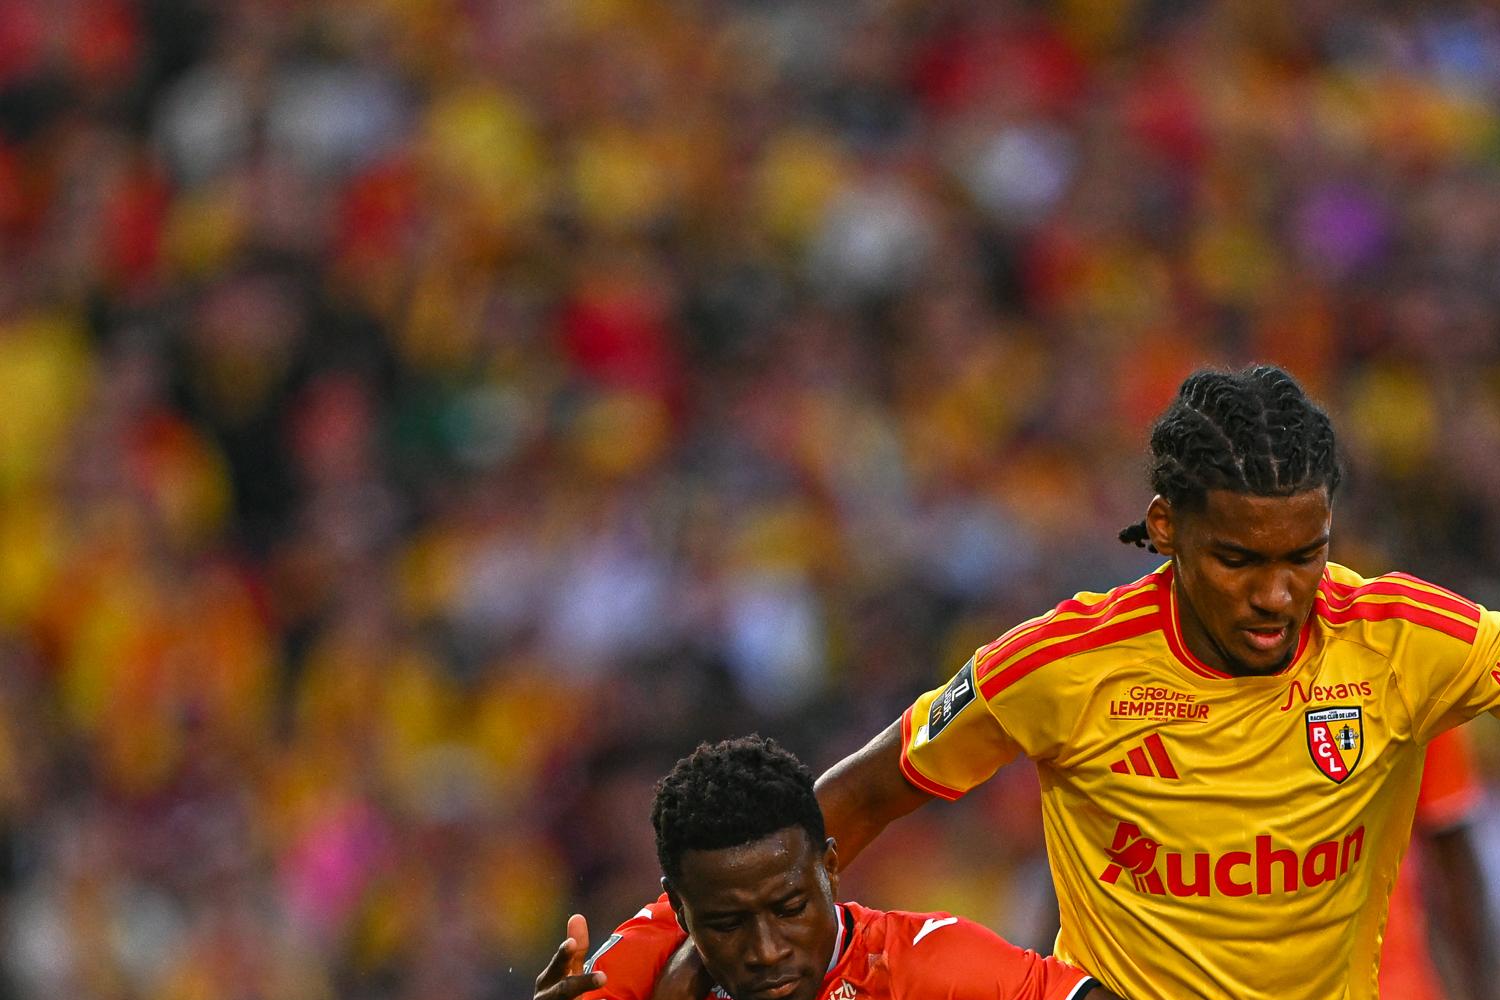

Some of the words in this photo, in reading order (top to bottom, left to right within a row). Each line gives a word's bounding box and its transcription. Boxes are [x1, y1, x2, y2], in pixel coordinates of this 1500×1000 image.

[1130, 686, 1197, 703] GROUPE
[1280, 680, 1372, 712] Nexans
[1110, 700, 1210, 719] LEMPEREUR
[1098, 821, 1366, 897] Auchan
